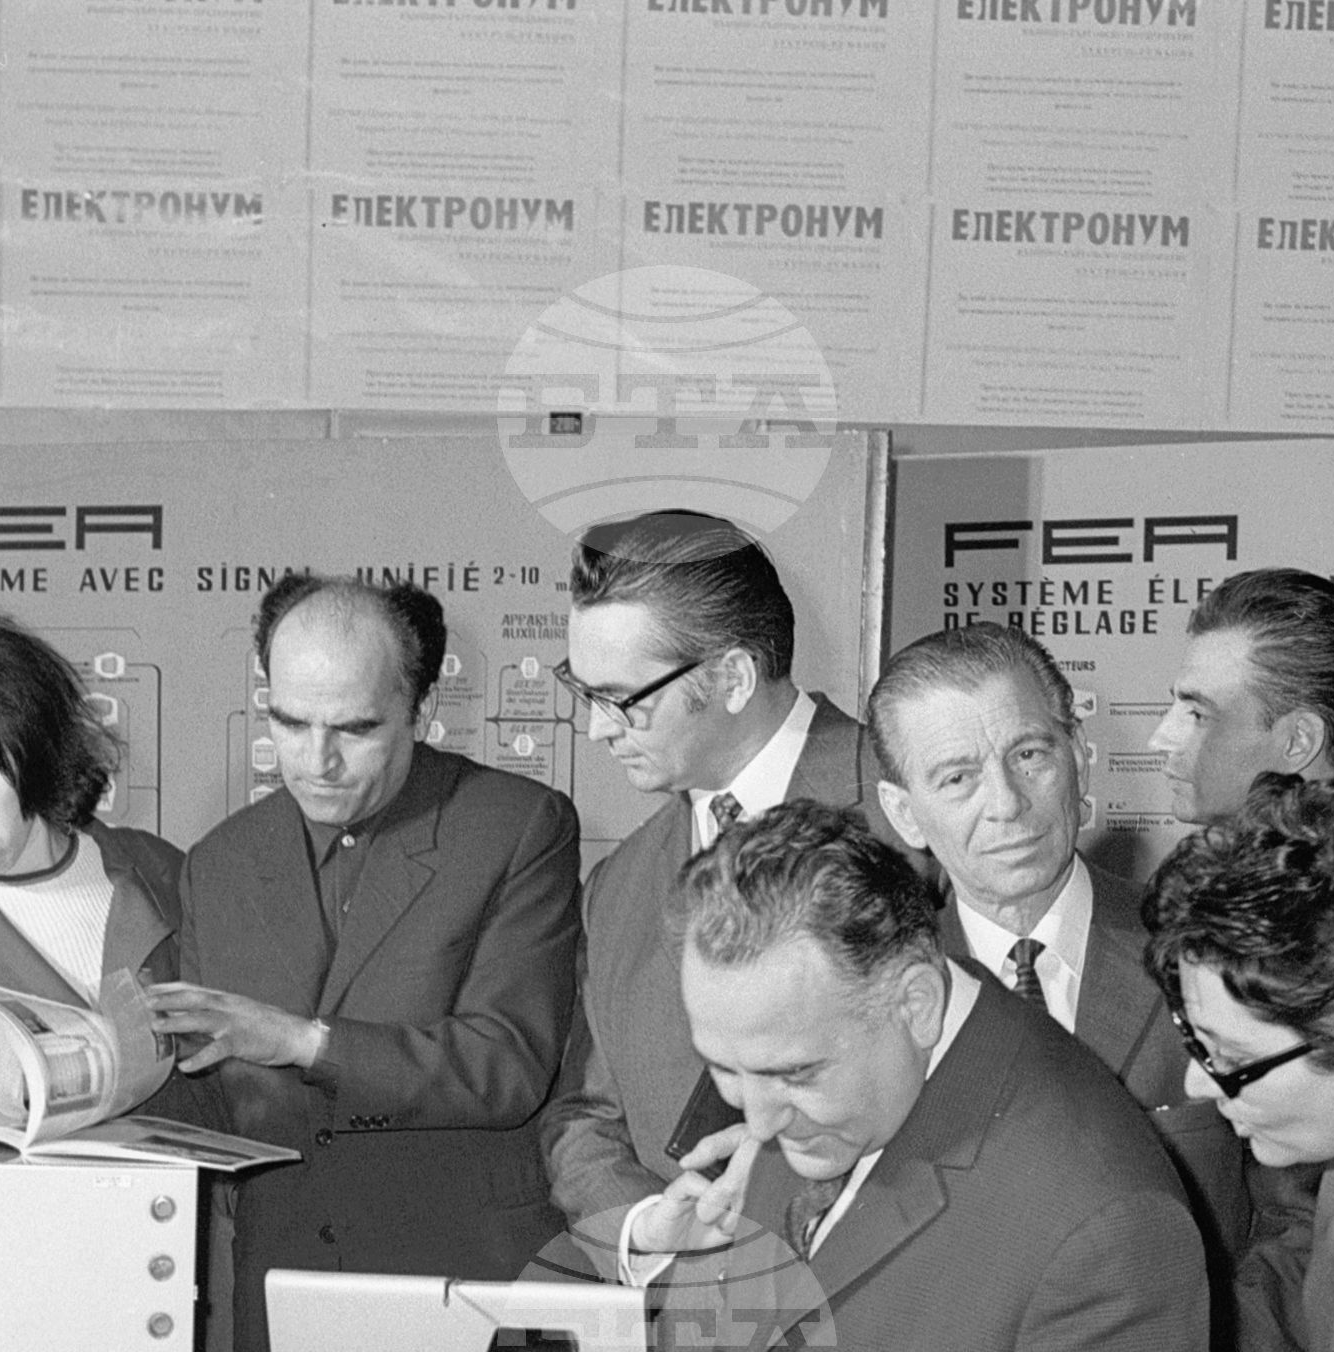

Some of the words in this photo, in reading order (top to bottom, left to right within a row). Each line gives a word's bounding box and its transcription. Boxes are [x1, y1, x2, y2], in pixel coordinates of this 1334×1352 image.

[20, 188, 264, 225] ЕЛЕКТРОНУМ
[331, 194, 575, 232] ЕЛЕКТРОНУМ
[643, 201, 885, 240] ЕЛЕКТРОНУМ
[951, 208, 1191, 248] ЕЛЕКТРОНУМ
[943, 513, 1240, 568] FEA
[79, 566, 165, 593] AVEC
[492, 565, 541, 585] 2-10
[943, 577, 1114, 607] SYSTÈME
[502, 627, 568, 641] AUXILIAIRE
[1007, 606, 1159, 636] RÉGLAGE
